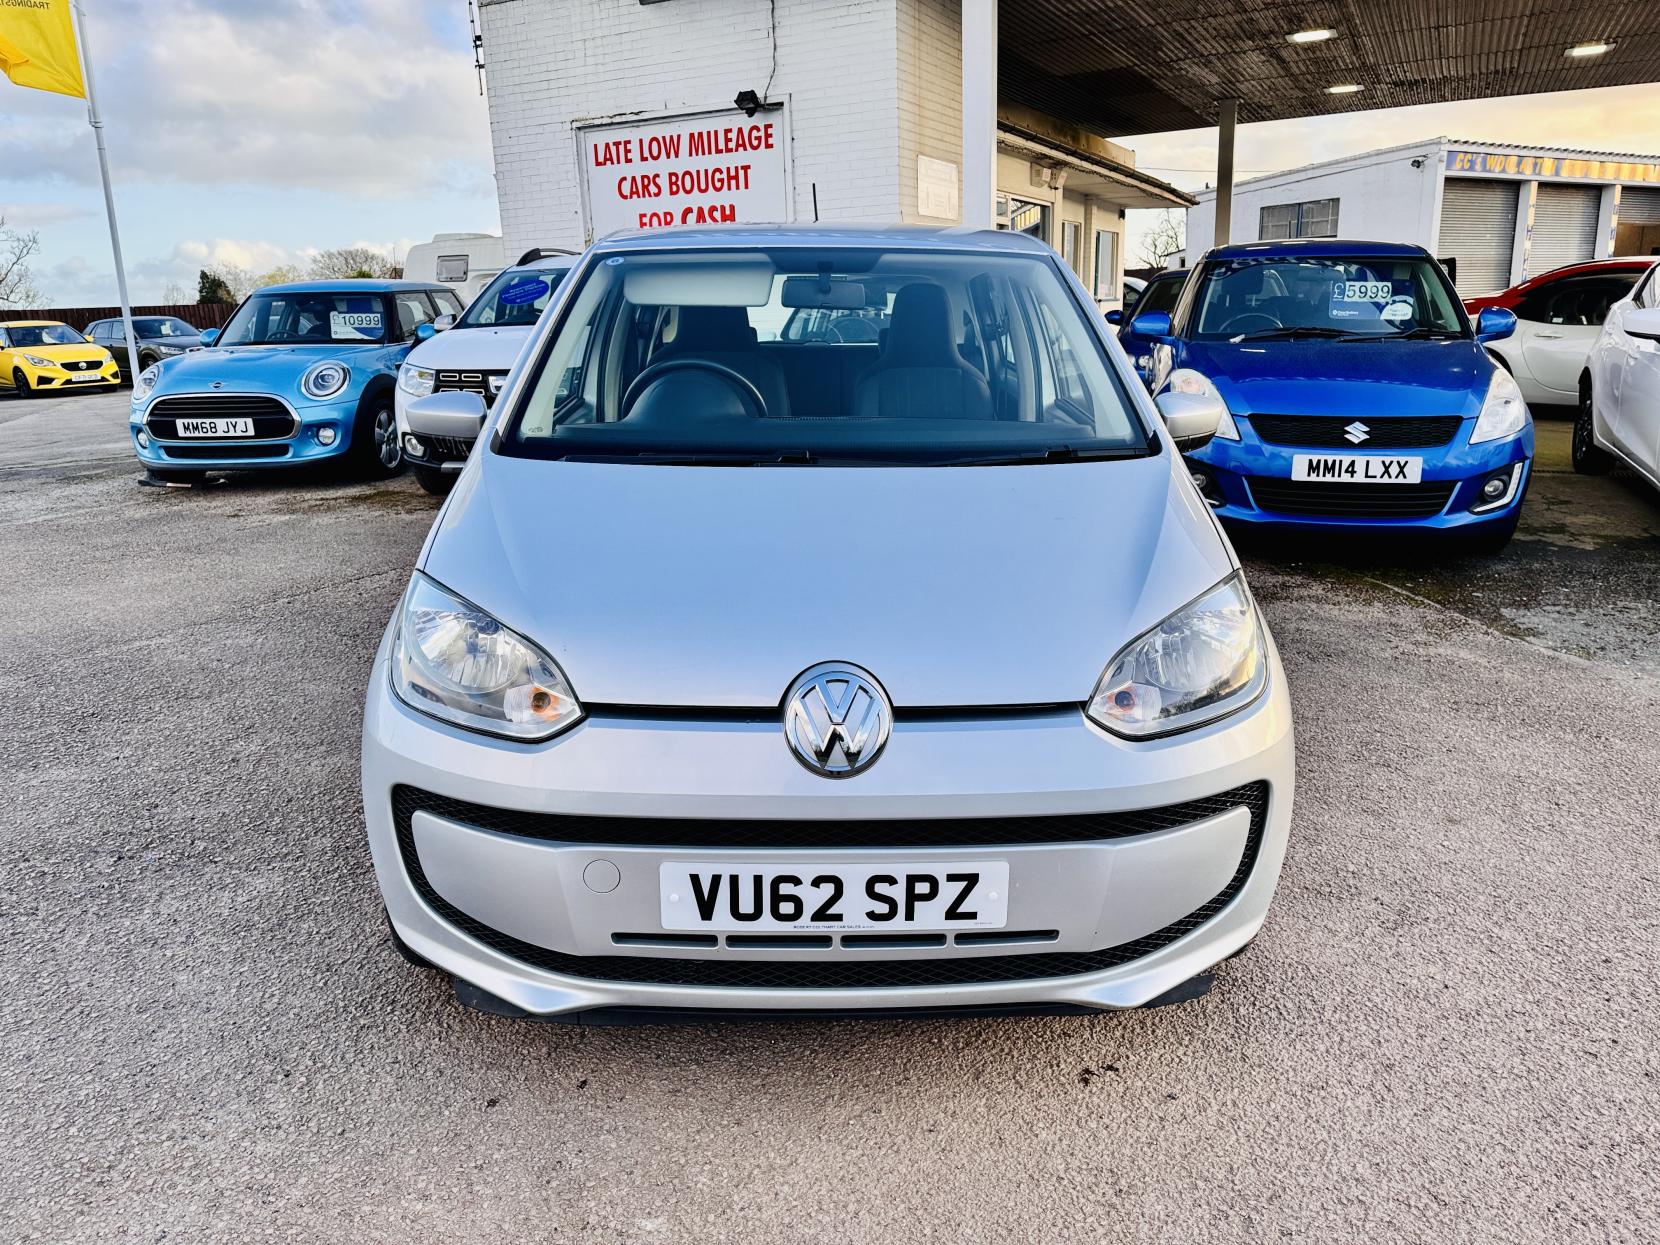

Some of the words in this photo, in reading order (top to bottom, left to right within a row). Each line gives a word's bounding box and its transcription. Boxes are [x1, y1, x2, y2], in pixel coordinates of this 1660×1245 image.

[593, 139, 633, 167] LATE
[638, 133, 682, 163] LOW
[688, 123, 774, 158] MILEAGE
[617, 172, 662, 200] CARS
[668, 164, 752, 197] BOUGHT
[182, 421, 218, 434] MM68
[222, 420, 248, 434] JYJ
[1307, 458, 1357, 478] MM14
[1364, 459, 1409, 479] LXX
[689, 873, 844, 923] VU62
[864, 872, 980, 922] SPZ
